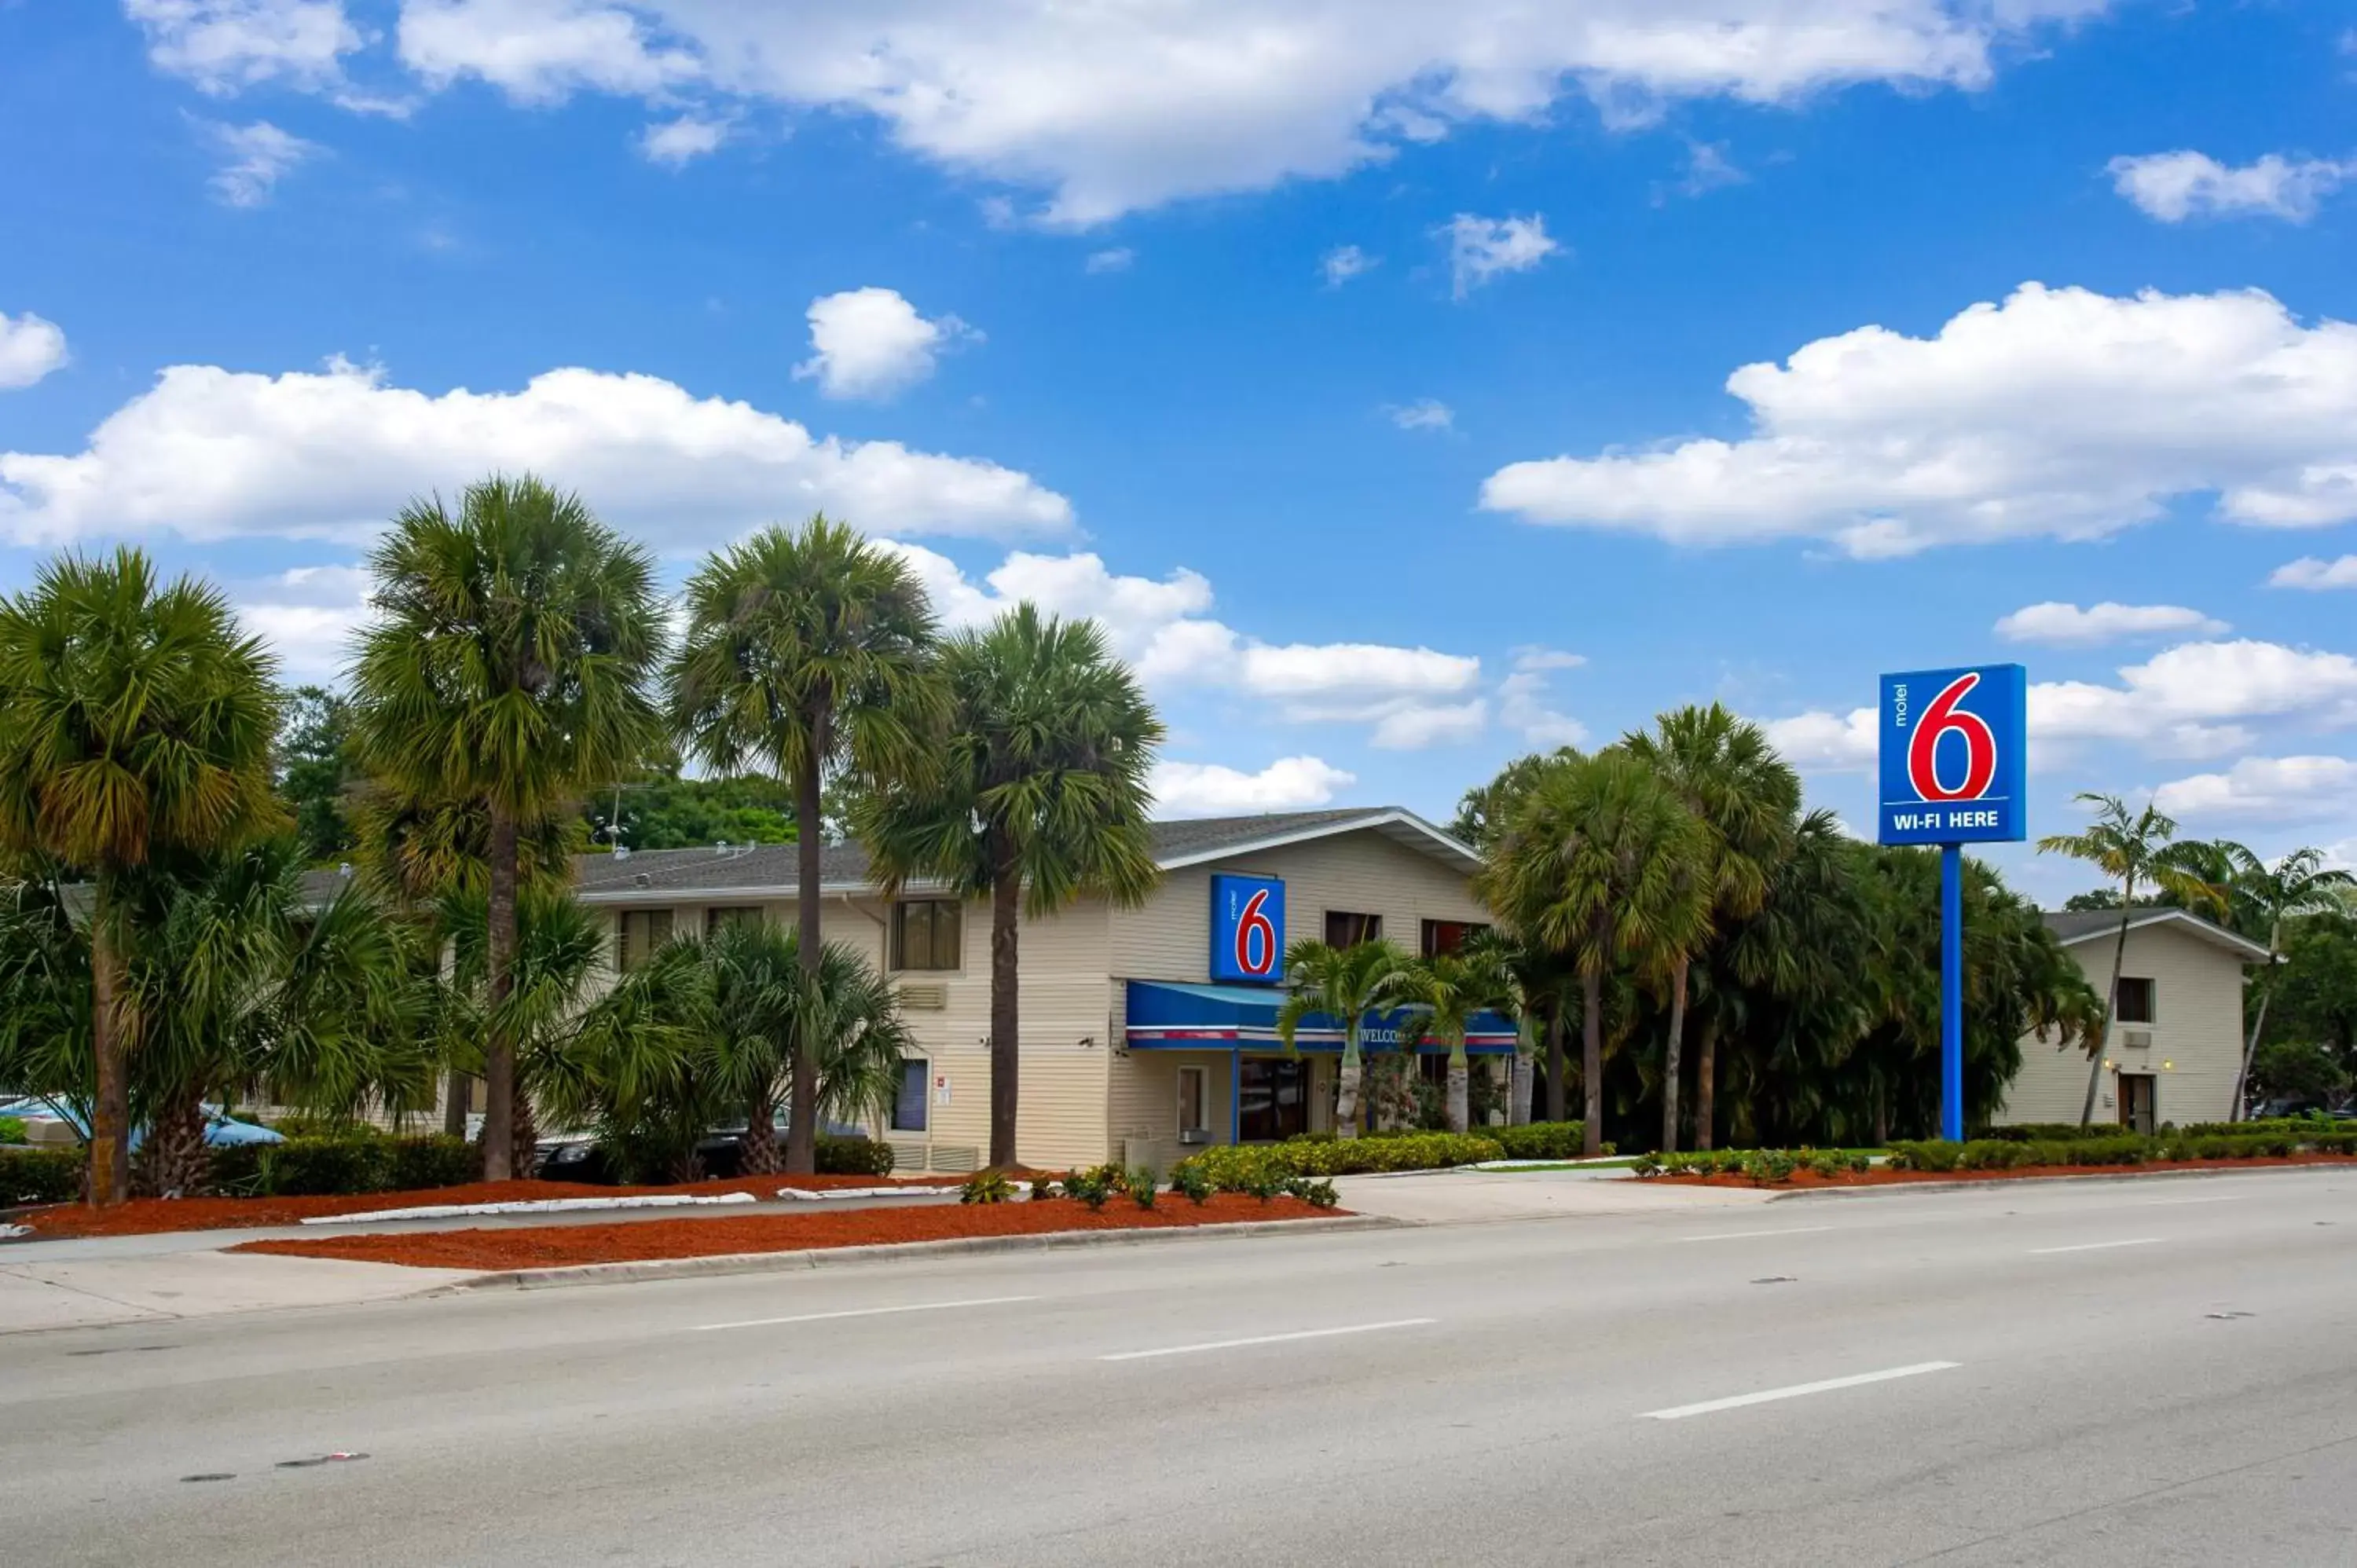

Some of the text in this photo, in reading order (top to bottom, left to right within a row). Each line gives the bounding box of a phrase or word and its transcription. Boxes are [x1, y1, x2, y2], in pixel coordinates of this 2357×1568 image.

[1893, 684, 1907, 727] motel
[1908, 672, 1996, 801] 6
[1893, 810, 1999, 830] WI-FI HERE
[1235, 888, 1275, 974] 6
[1360, 1028, 1412, 1042] WELCO
